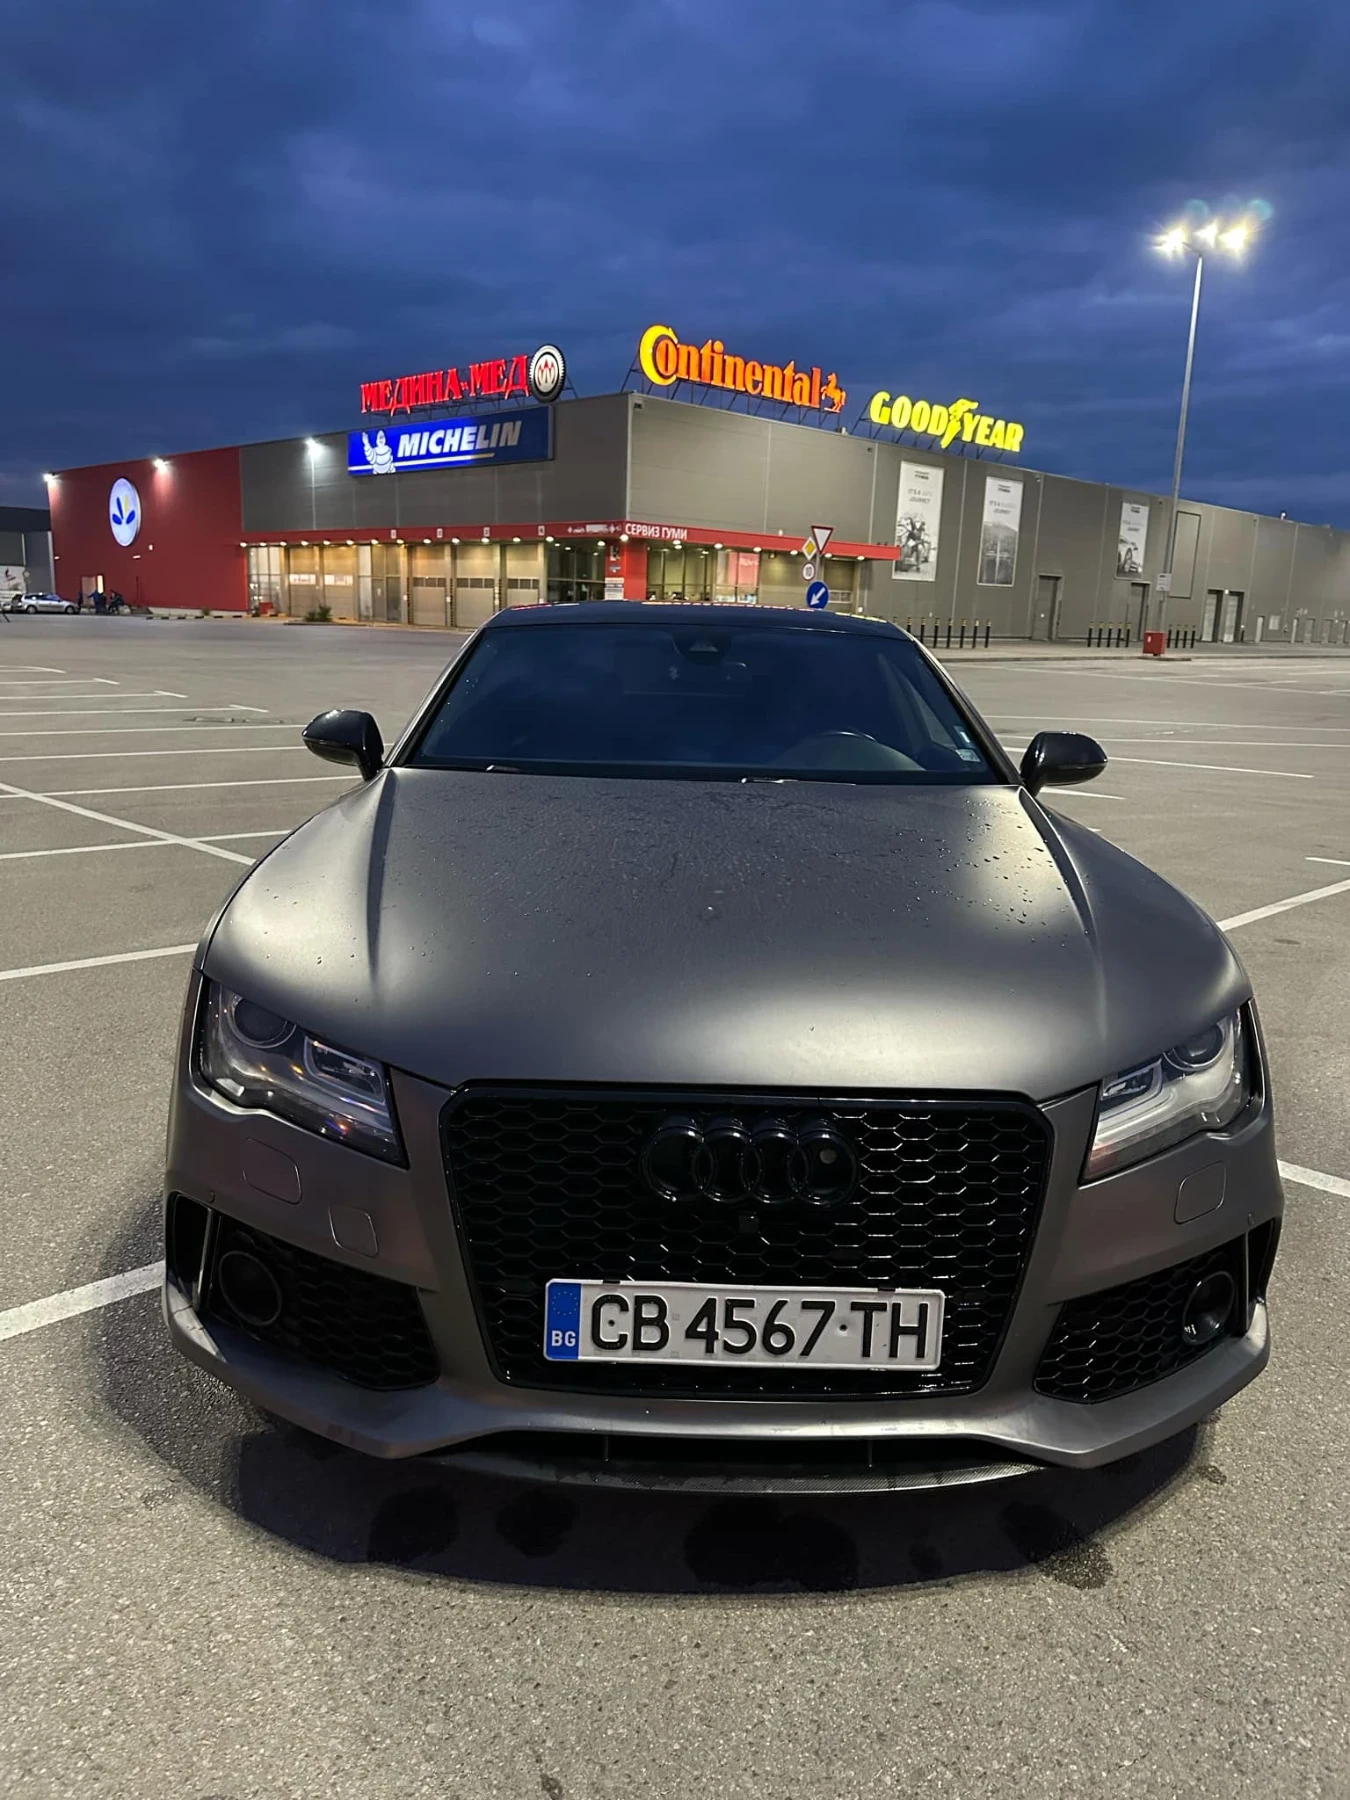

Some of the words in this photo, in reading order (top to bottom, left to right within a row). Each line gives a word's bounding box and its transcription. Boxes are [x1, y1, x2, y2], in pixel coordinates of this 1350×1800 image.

[360, 355, 529, 416] МЕДИНА-МЕД
[638, 323, 821, 409] Continental
[397, 420, 522, 458] MICHELIN
[625, 523, 660, 538] СЕРВИЗ
[661, 527, 688, 540] ГУМИ
[551, 1329, 577, 1347] BG
[591, 1294, 669, 1352] CB
[685, 1297, 836, 1356] 4567
[850, 1301, 929, 1359] TH
